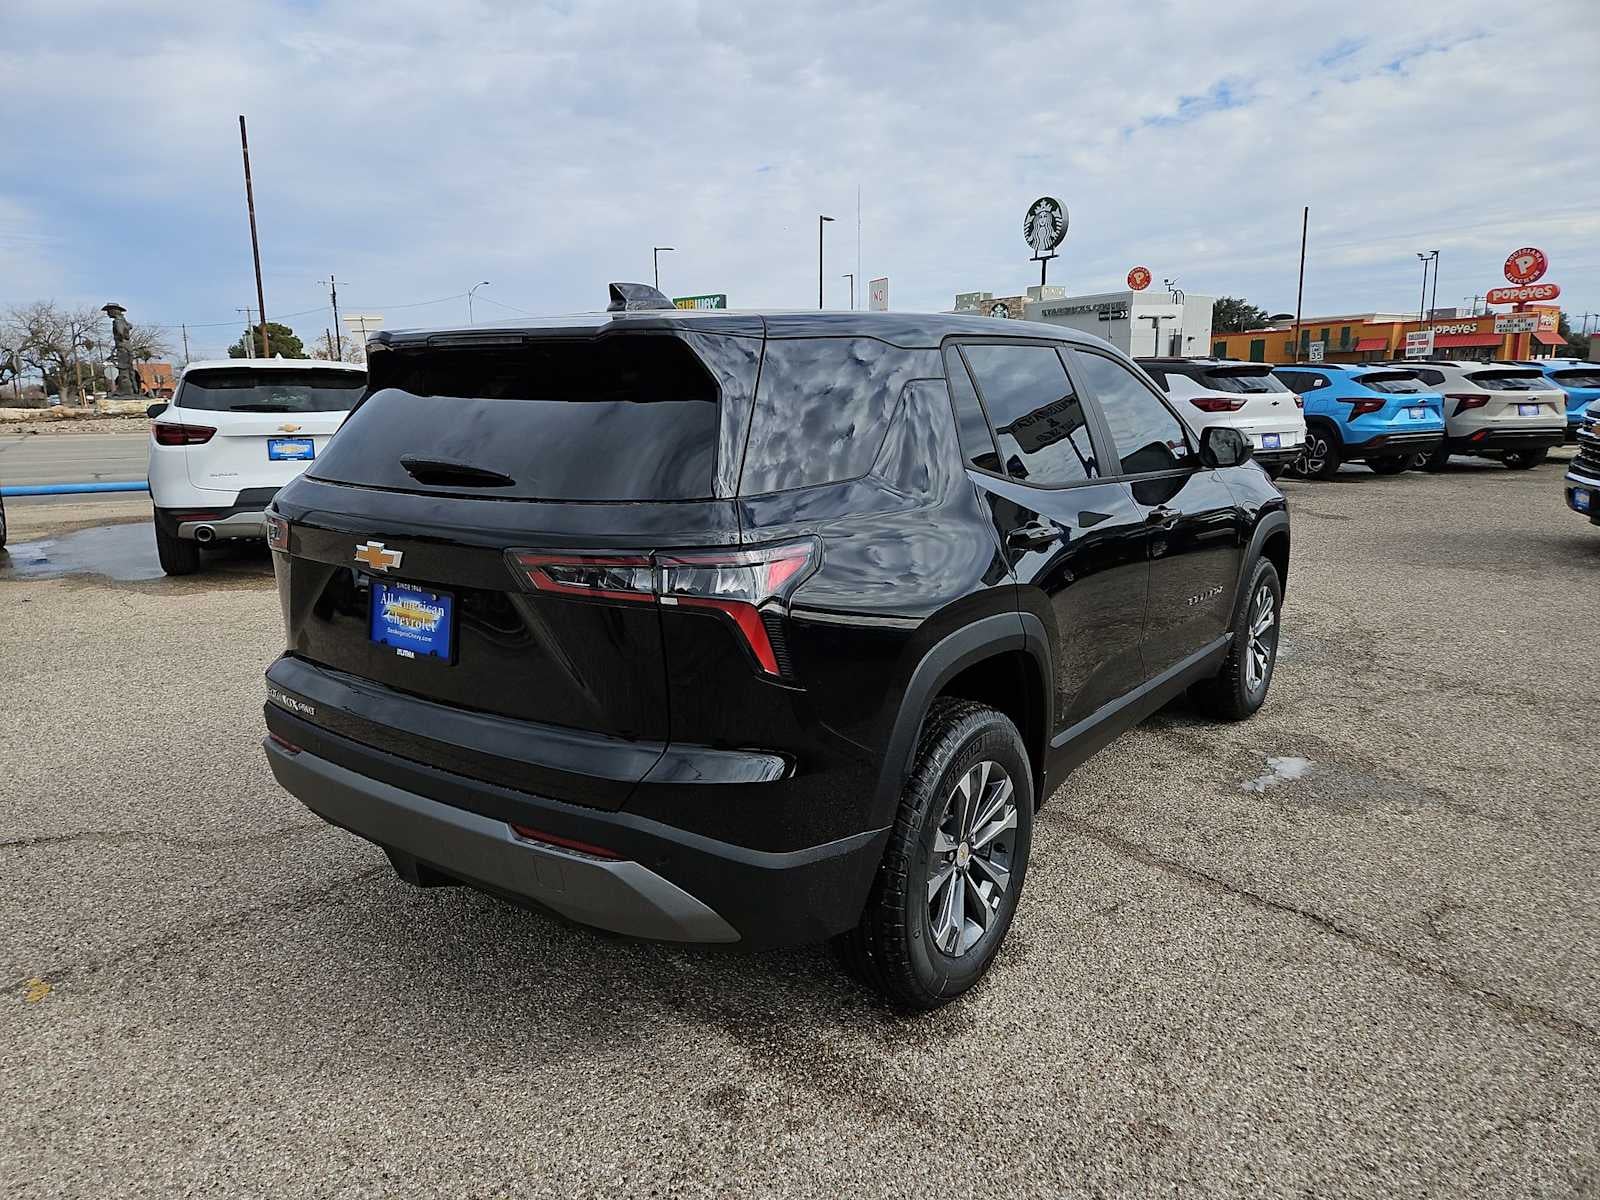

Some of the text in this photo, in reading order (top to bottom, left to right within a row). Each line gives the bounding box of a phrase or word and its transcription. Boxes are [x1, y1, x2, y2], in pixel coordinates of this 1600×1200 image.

[1311, 352, 1322, 360] 35
[380, 592, 445, 617] All American
[385, 609, 436, 633] Chevrolet
